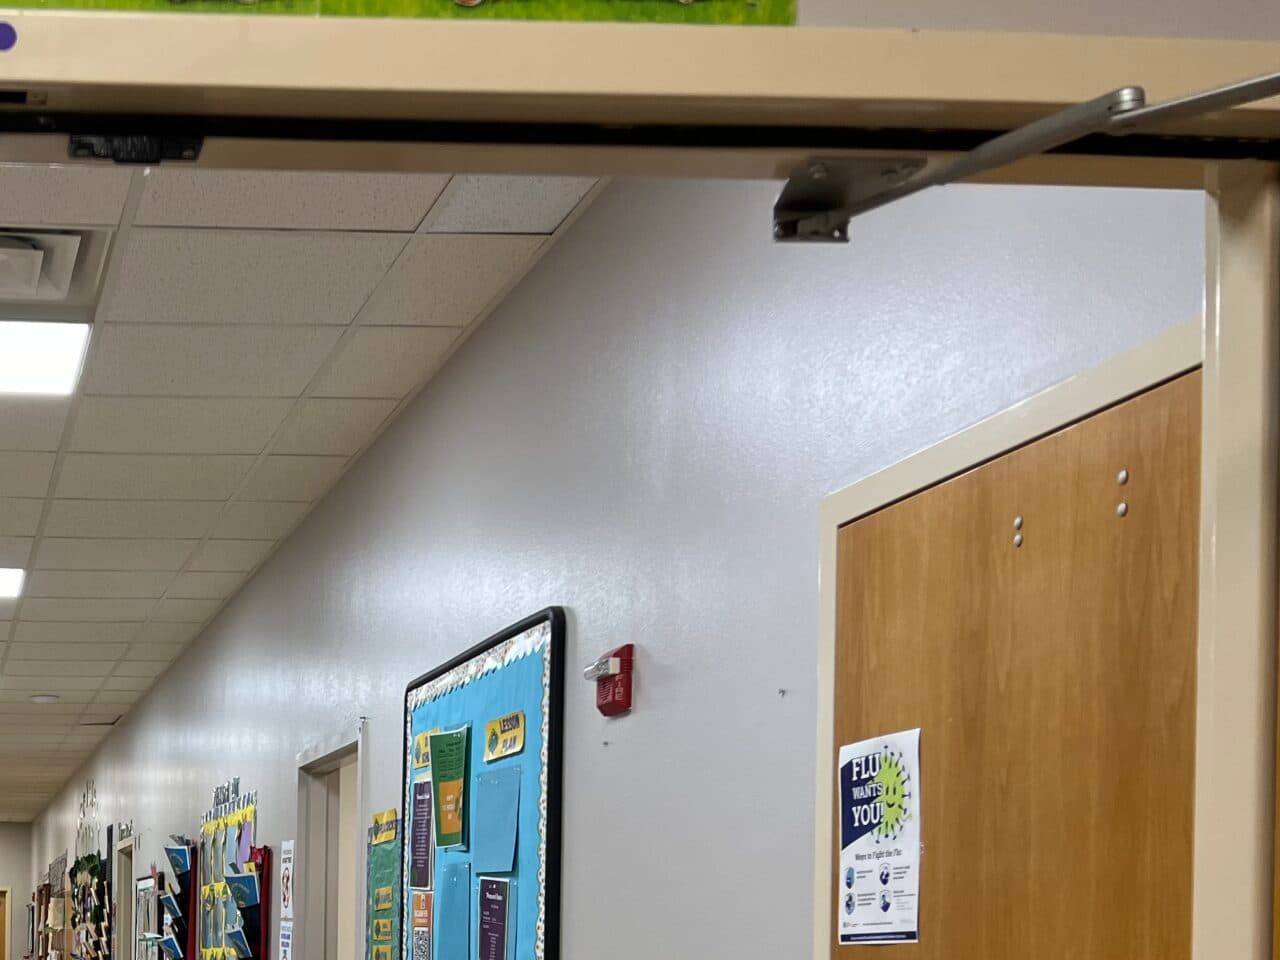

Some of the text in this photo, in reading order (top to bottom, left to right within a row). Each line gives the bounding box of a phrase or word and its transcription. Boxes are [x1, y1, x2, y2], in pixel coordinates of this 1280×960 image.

[499, 714, 520, 734] LESSON
[851, 753, 881, 781] FLU
[851, 783, 883, 800] WANTS
[851, 803, 884, 827] YOU!
